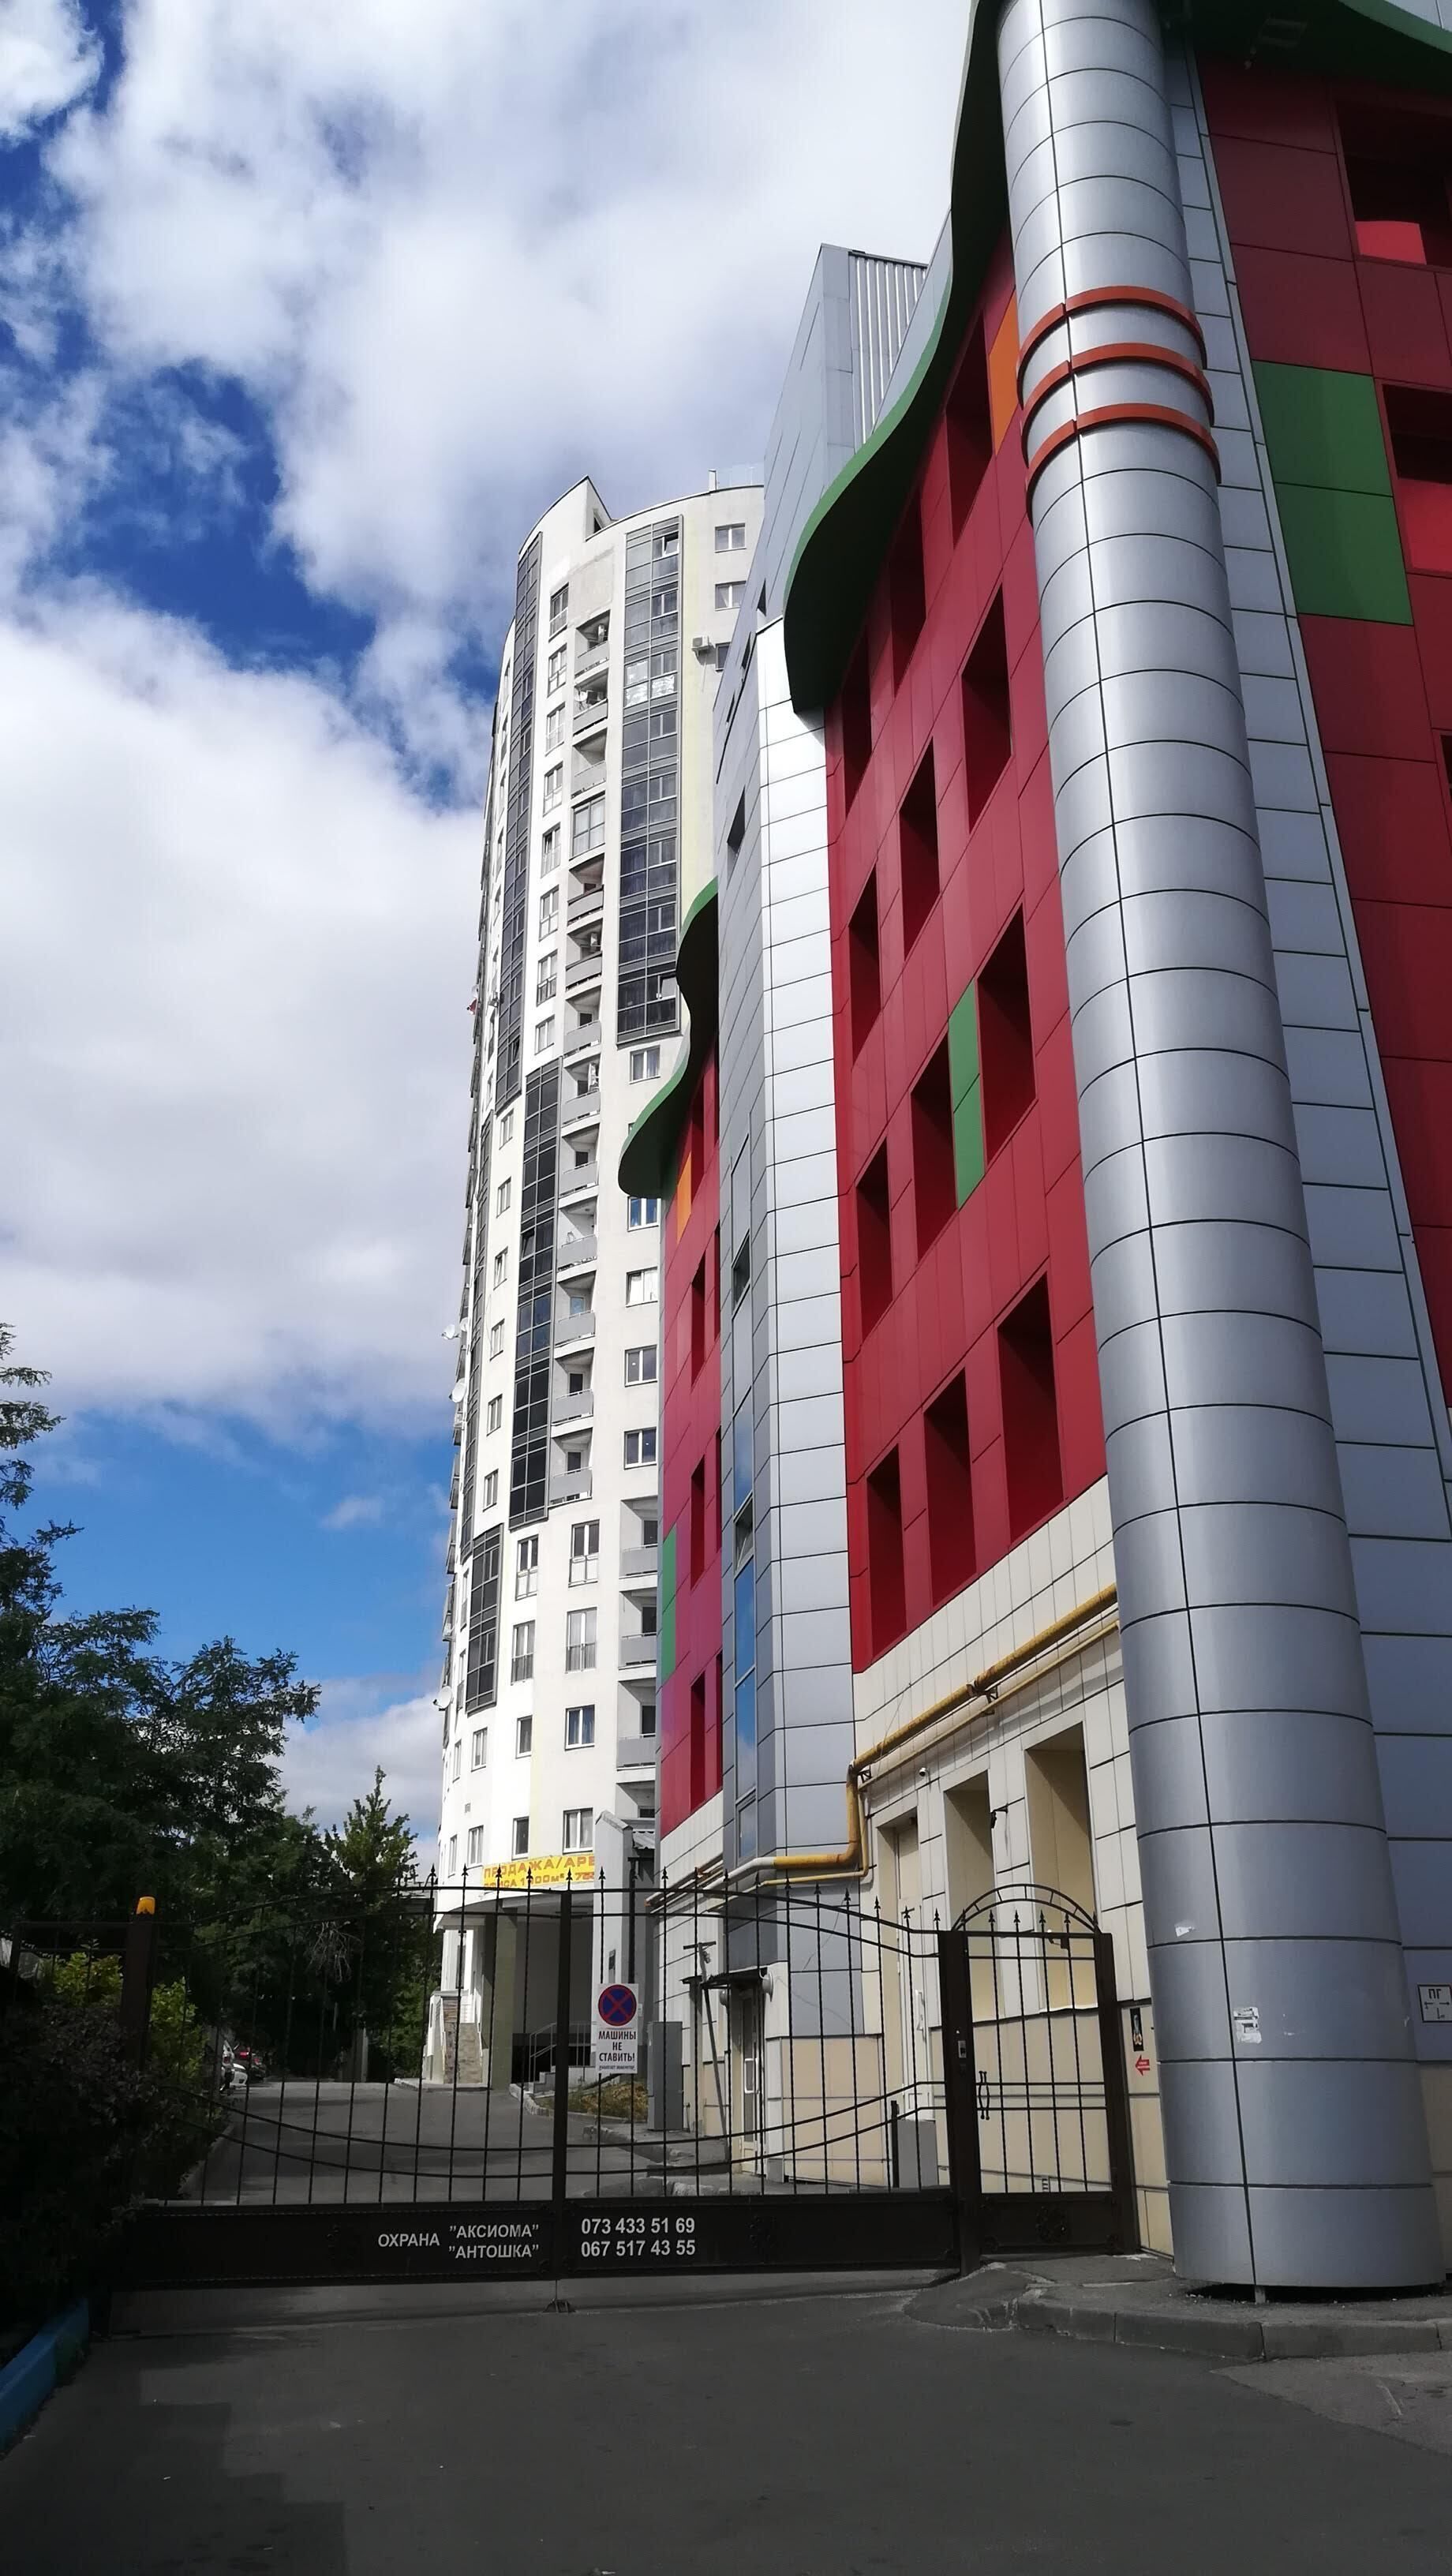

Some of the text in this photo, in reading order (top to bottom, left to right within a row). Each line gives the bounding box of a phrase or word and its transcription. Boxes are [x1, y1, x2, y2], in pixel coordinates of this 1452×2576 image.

[1428, 1988, 1442, 2000] ПГ
[598, 2031, 637, 2040] МАШИНЫ
[612, 2042, 623, 2051] НЕ
[599, 2052, 635, 2062] СТАВИТЬ!
[449, 2224, 539, 2238] "АКСИОМА"
[581, 2217, 695, 2234] 073 433 51 69
[377, 2233, 440, 2247] ОХРАНА
[448, 2244, 539, 2259] "АНТОШКА"
[581, 2239, 696, 2257] 067 517 43 55
